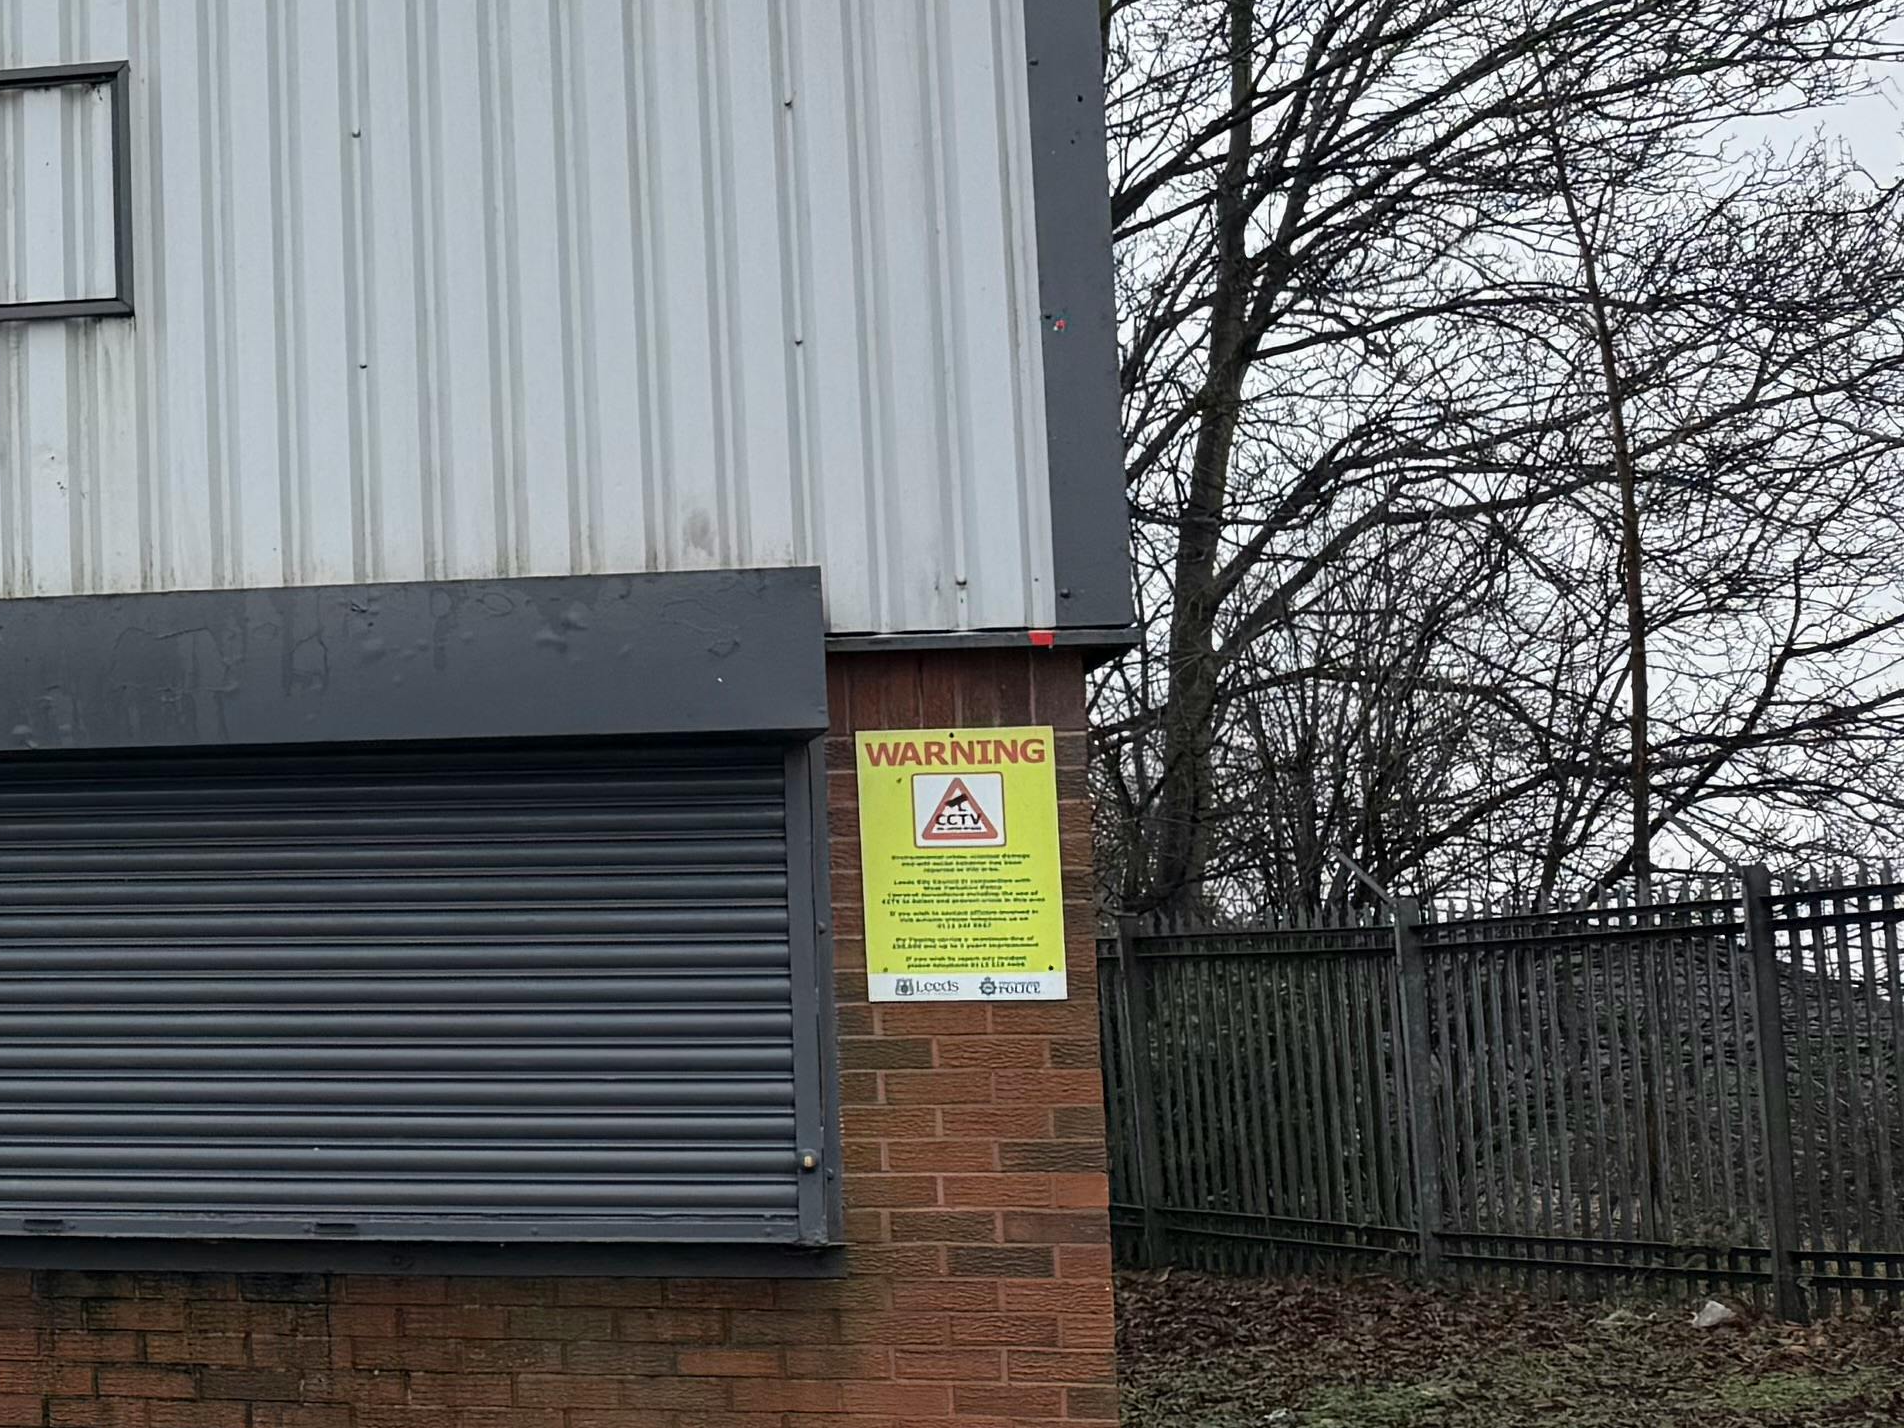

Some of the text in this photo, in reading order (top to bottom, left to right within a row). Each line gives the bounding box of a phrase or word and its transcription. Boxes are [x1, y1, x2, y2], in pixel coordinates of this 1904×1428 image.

[865, 738, 1045, 767] WARNING
[935, 813, 981, 826] CCTV
[916, 980, 959, 992] Leeds
